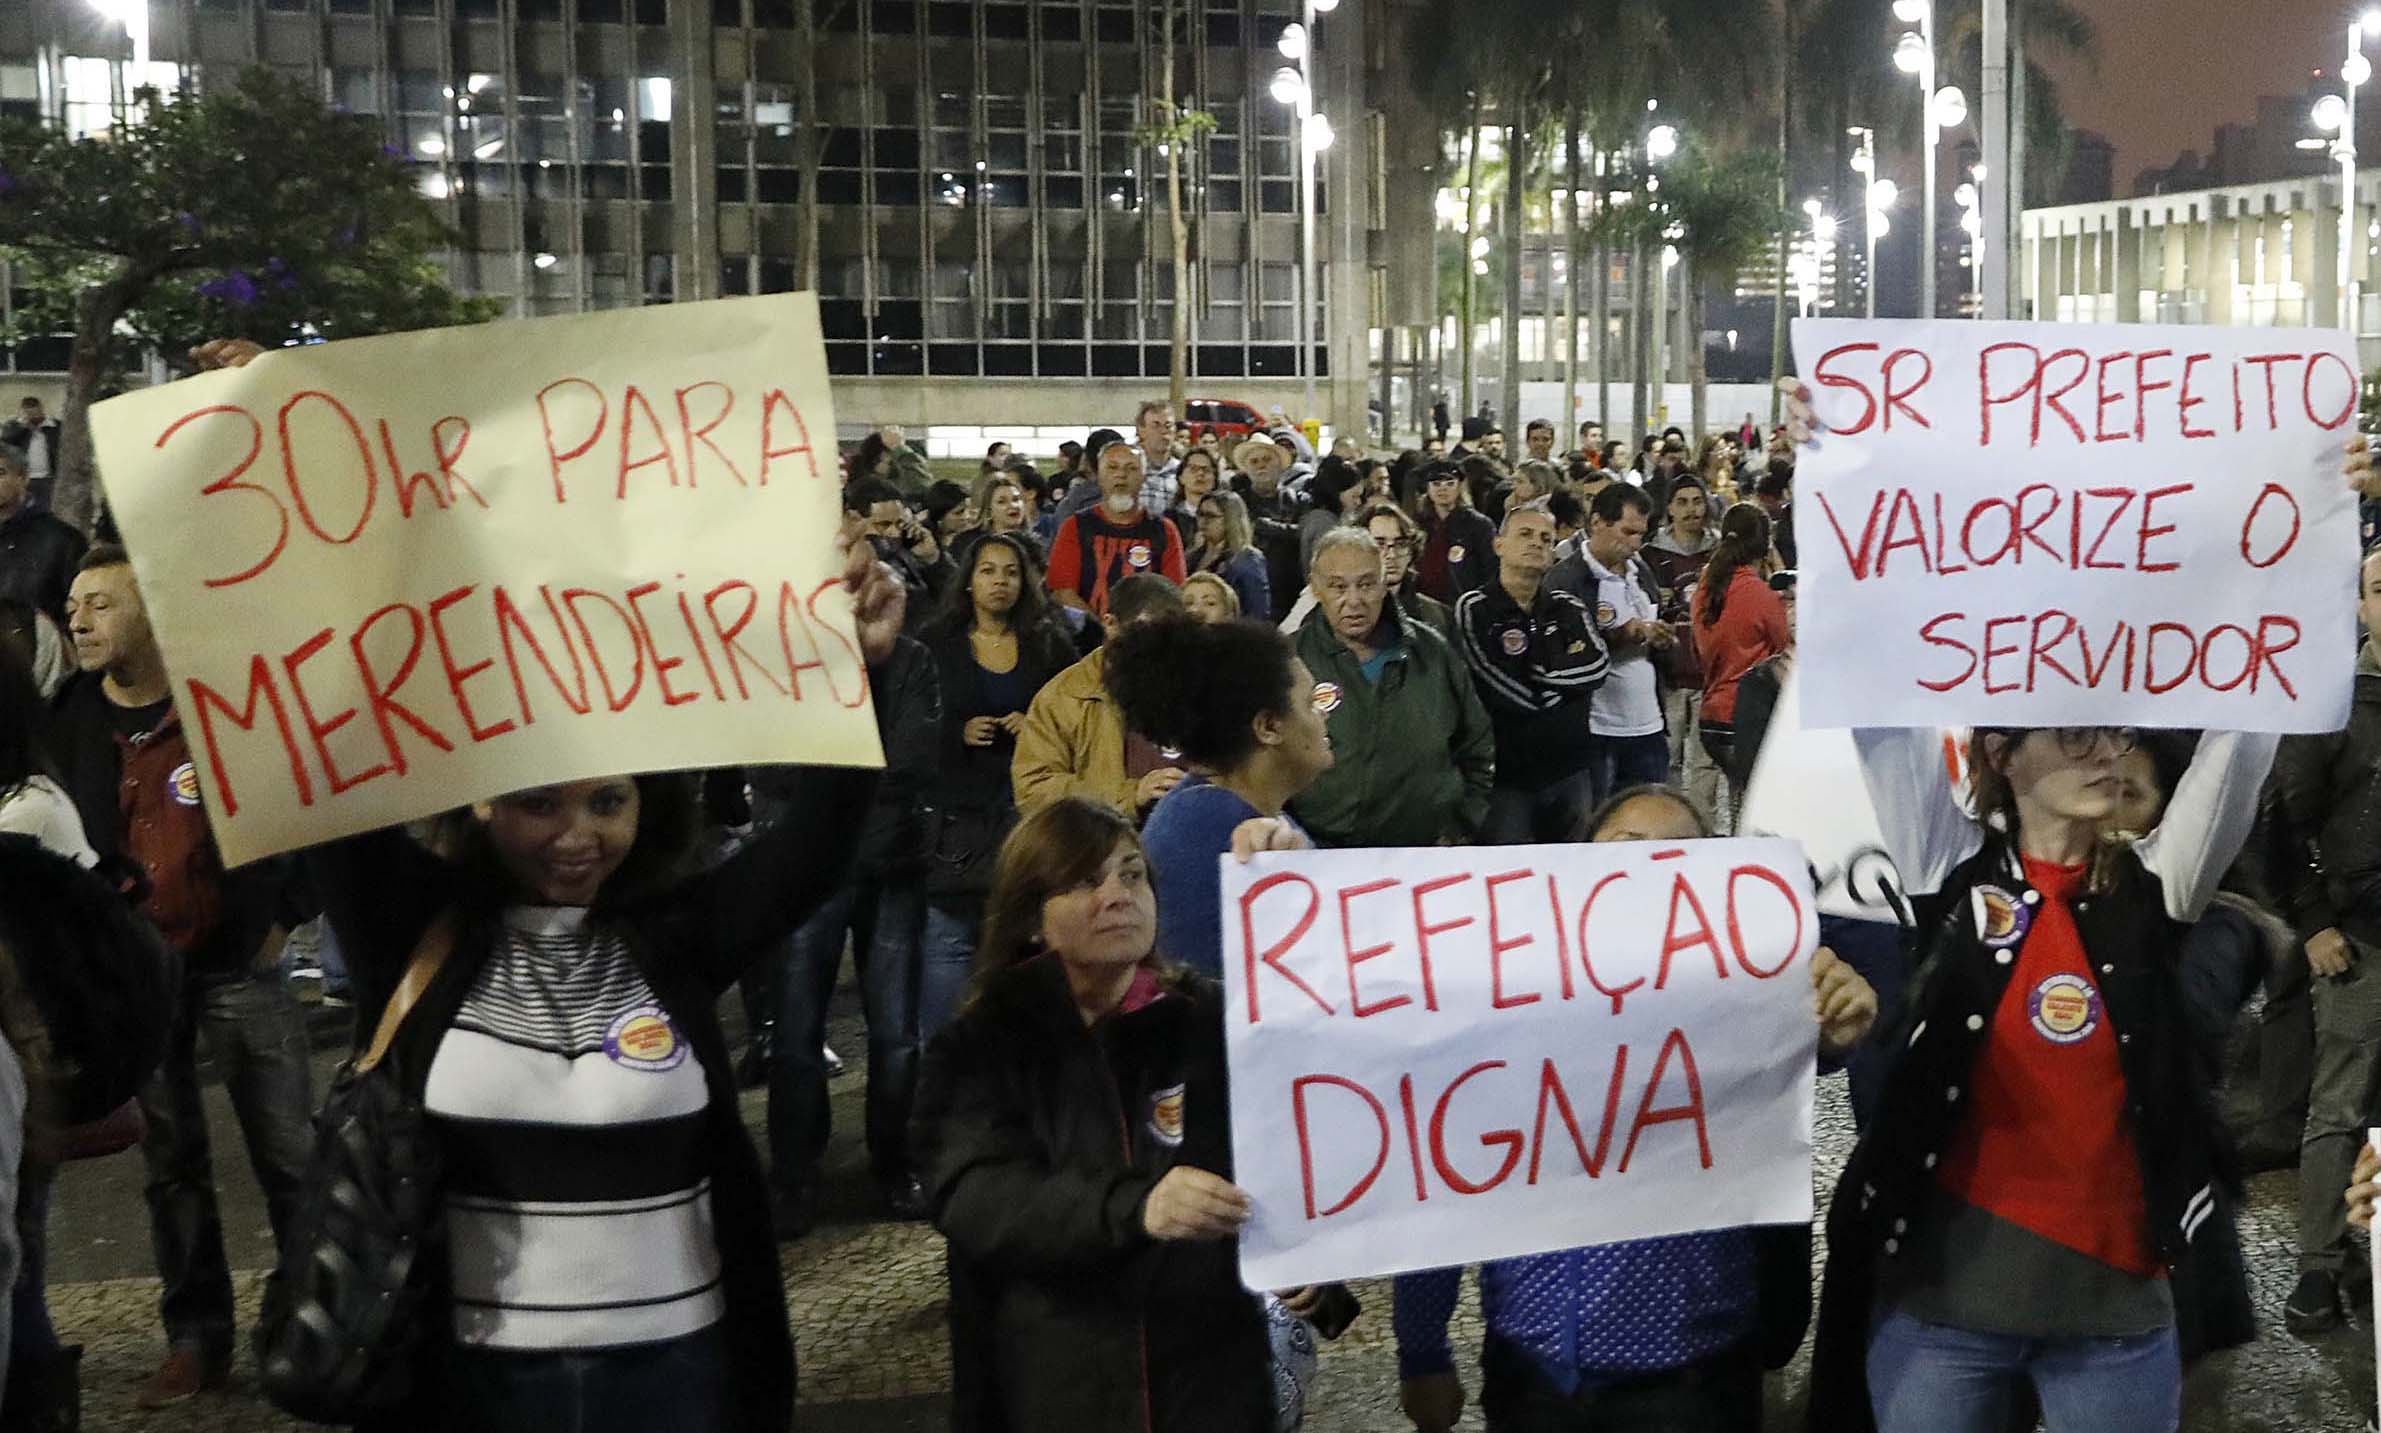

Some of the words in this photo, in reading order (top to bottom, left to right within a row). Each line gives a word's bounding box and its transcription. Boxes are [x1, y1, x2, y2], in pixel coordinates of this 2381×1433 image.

[537, 377, 819, 503] PARA
[1814, 342, 1933, 436] SR
[1979, 342, 2357, 447] PREFEITO
[1816, 483, 2194, 581] VALORIZE
[2240, 482, 2302, 569] O
[1918, 609, 2301, 701] SERVIDOR
[1239, 848, 1801, 1024] REFEIÇÃO
[1290, 1029, 1712, 1220] DIGNA
